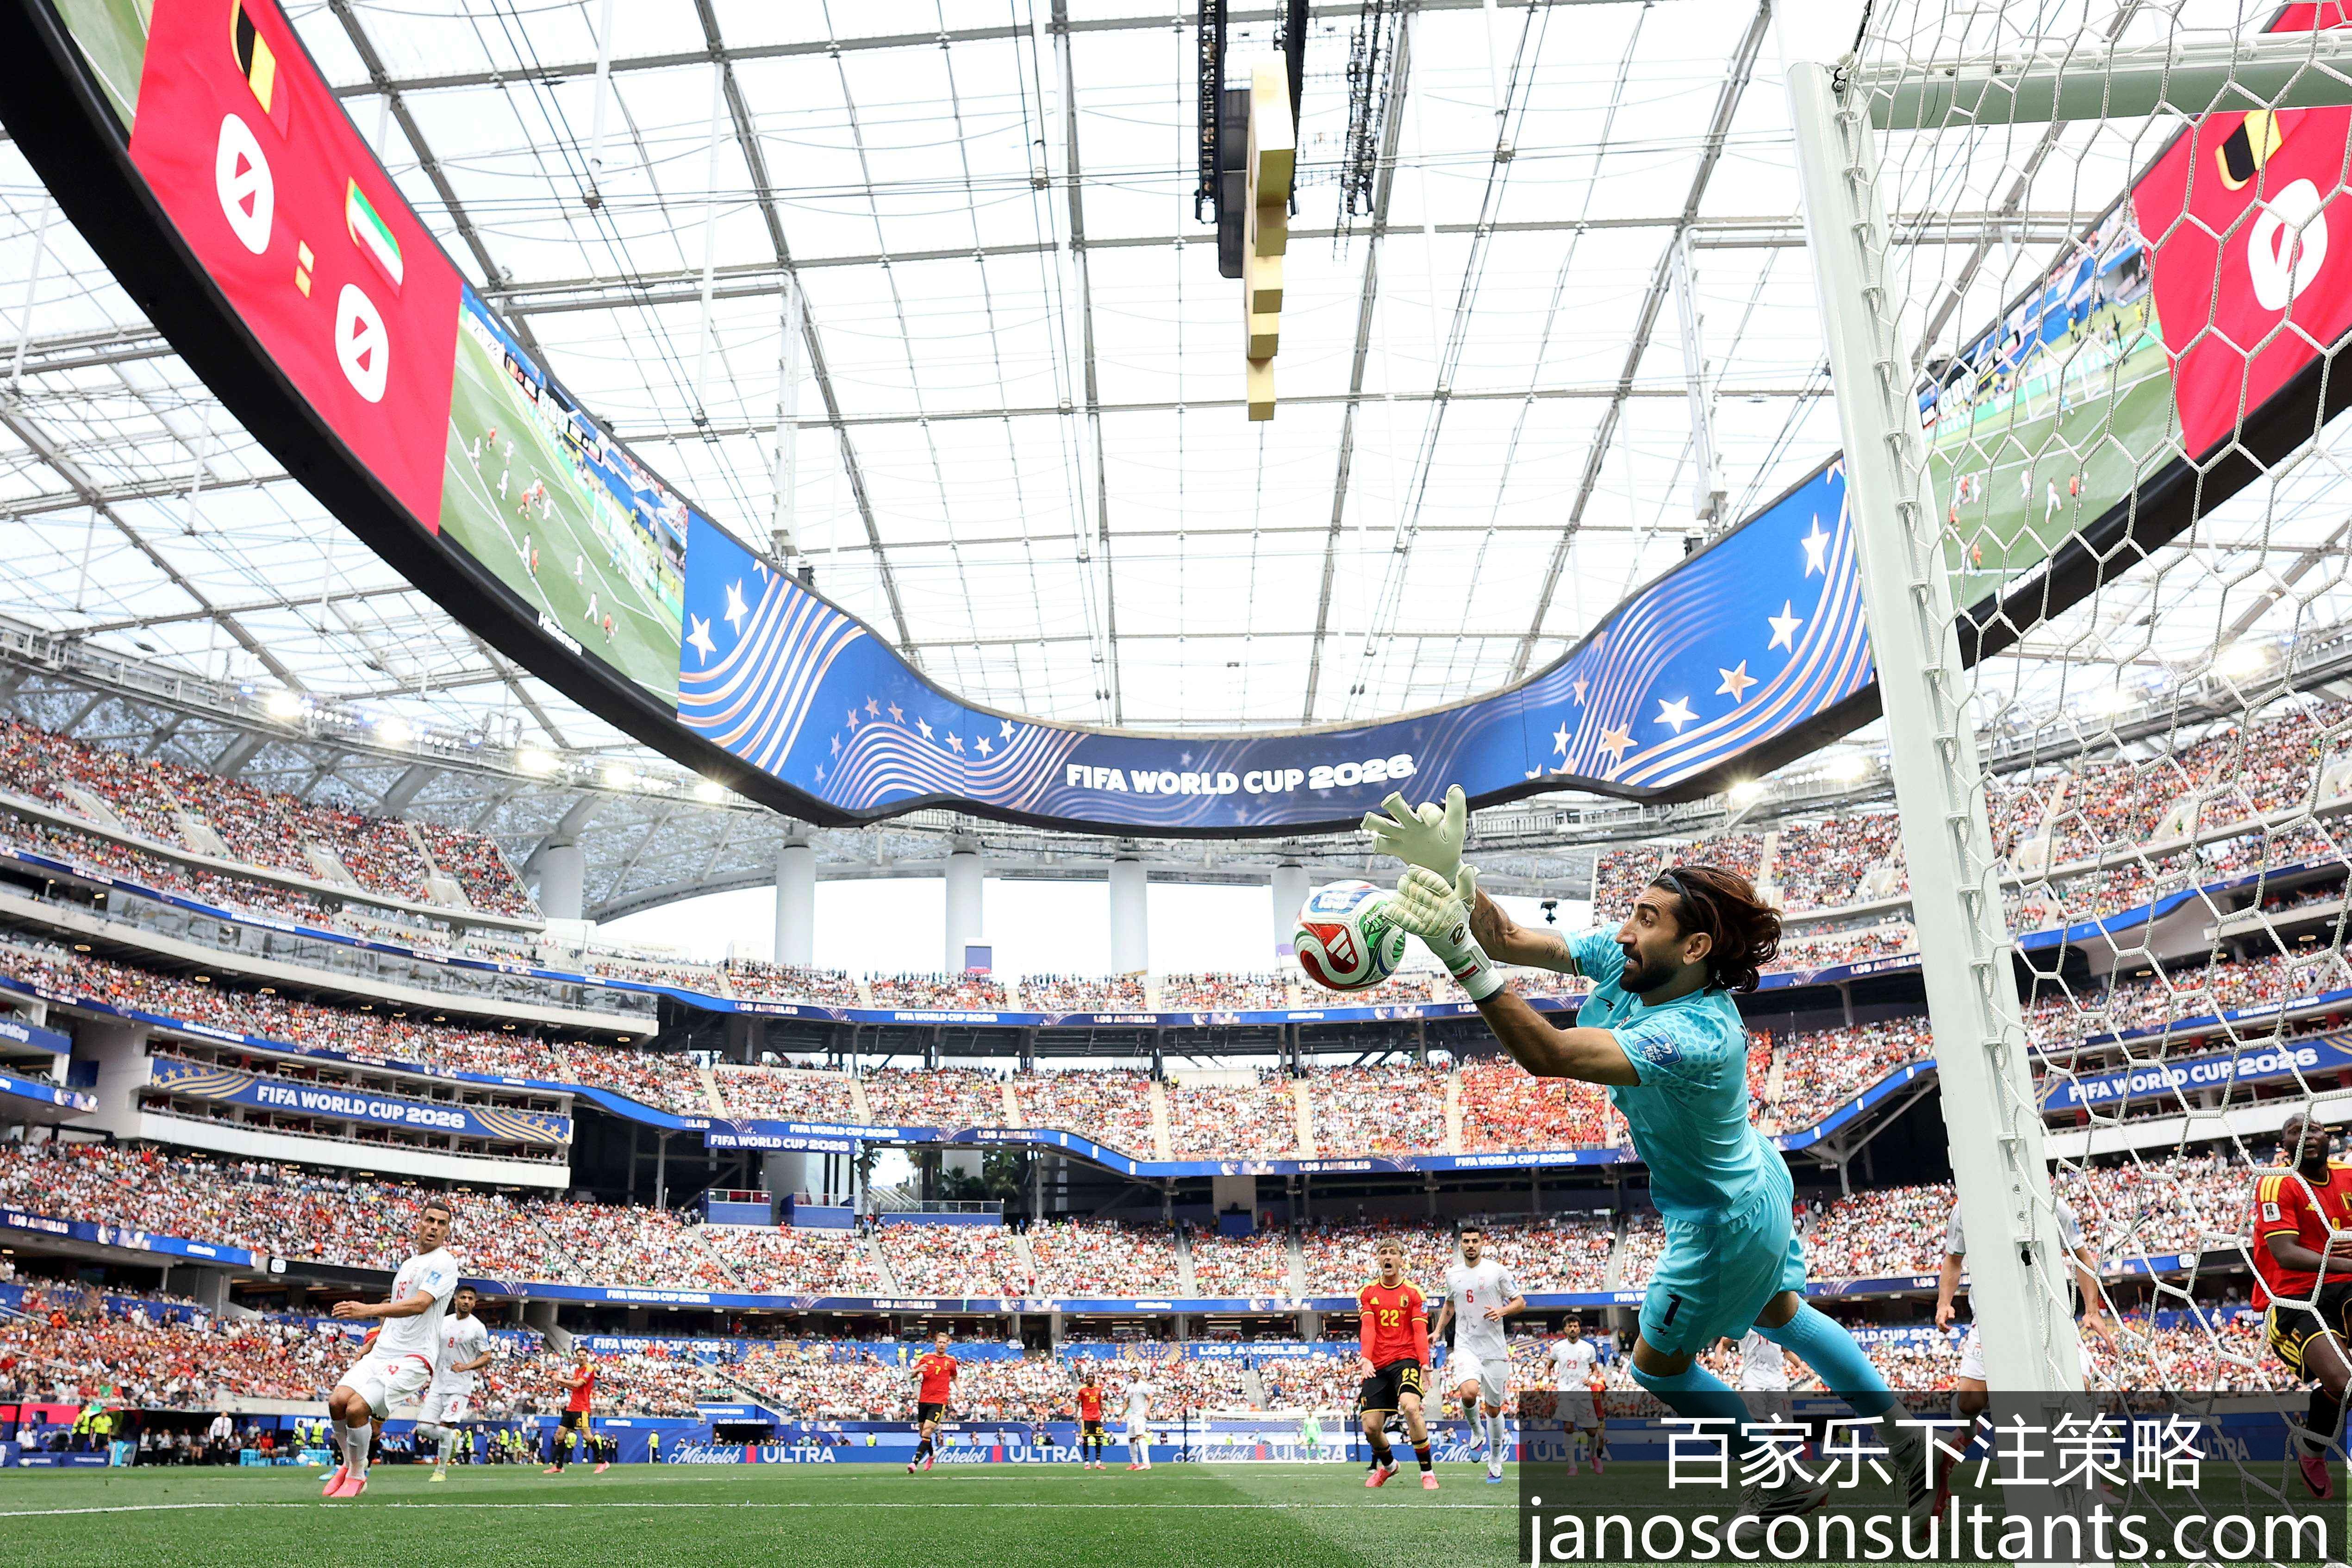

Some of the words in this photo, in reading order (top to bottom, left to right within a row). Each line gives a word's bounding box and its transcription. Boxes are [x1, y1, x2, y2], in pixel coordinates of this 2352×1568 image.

[1067, 763, 1127, 792] FIFA
[1130, 769, 1239, 795] WORLD
[1243, 768, 1299, 794] CUP
[1308, 753, 1416, 790] 2026
[894, 1012, 913, 1022] FIFA
[914, 1012, 947, 1022] WORLD
[947, 1013, 966, 1022] CUP
[1093, 1015, 1112, 1024] LOS
[2113, 1066, 2188, 1096] WORLD
[2190, 1061, 2233, 1082] CUP
[2236, 1048, 2320, 1075] 2026
[256, 1085, 298, 1106] FIFA
[300, 1091, 367, 1115] WORLD
[368, 1101, 405, 1120] CUP
[405, 1106, 466, 1129] 2026
[789, 1124, 809, 1134] FIFA
[810, 1125, 845, 1136] WORLD
[846, 1126, 865, 1137] CUP
[977, 1130, 998, 1139] LOS
[710, 1134, 737, 1147] FIFA
[738, 1135, 782, 1149] WORLD
[783, 1138, 807, 1150] CUP
[807, 1139, 849, 1152] 2026
[1298, 1162, 1321, 1172] LOS
[1455, 1156, 1479, 1167] FIFA
[1480, 1155, 1518, 1167] WORLD
[1518, 1154, 1539, 1165] CUP
[1913, 1277, 1936, 1288] LOS
[606, 1289, 626, 1299] FIFA
[627, 1290, 660, 1301] WORLD
[660, 1292, 679, 1302] CUP
[1466, 1289, 1473, 1303] 6
[873, 1299, 892, 1309] LOS
[892, 1299, 937, 1310] ANGELES
[1663, 1294, 1683, 1327] 1
[1379, 1308, 1400, 1327] 22
[1879, 1329, 1909, 1342] CUP
[448, 1337, 455, 1348] 8
[593, 1337, 620, 1350] FIFA
[1198, 1346, 1231, 1356] LOS
[1234, 1345, 1310, 1356] ANGELES
[1567, 1359, 1577, 1370] 23
[1402, 1367, 1419, 1383] 22
[451, 1400, 458, 1412] 8
[668, 1446, 741, 1464] Michelob
[763, 1446, 836, 1463] ULTRA
[1009, 1445, 1083, 1462] ULTRA
[2194, 1437, 2251, 1461] ULTRA
